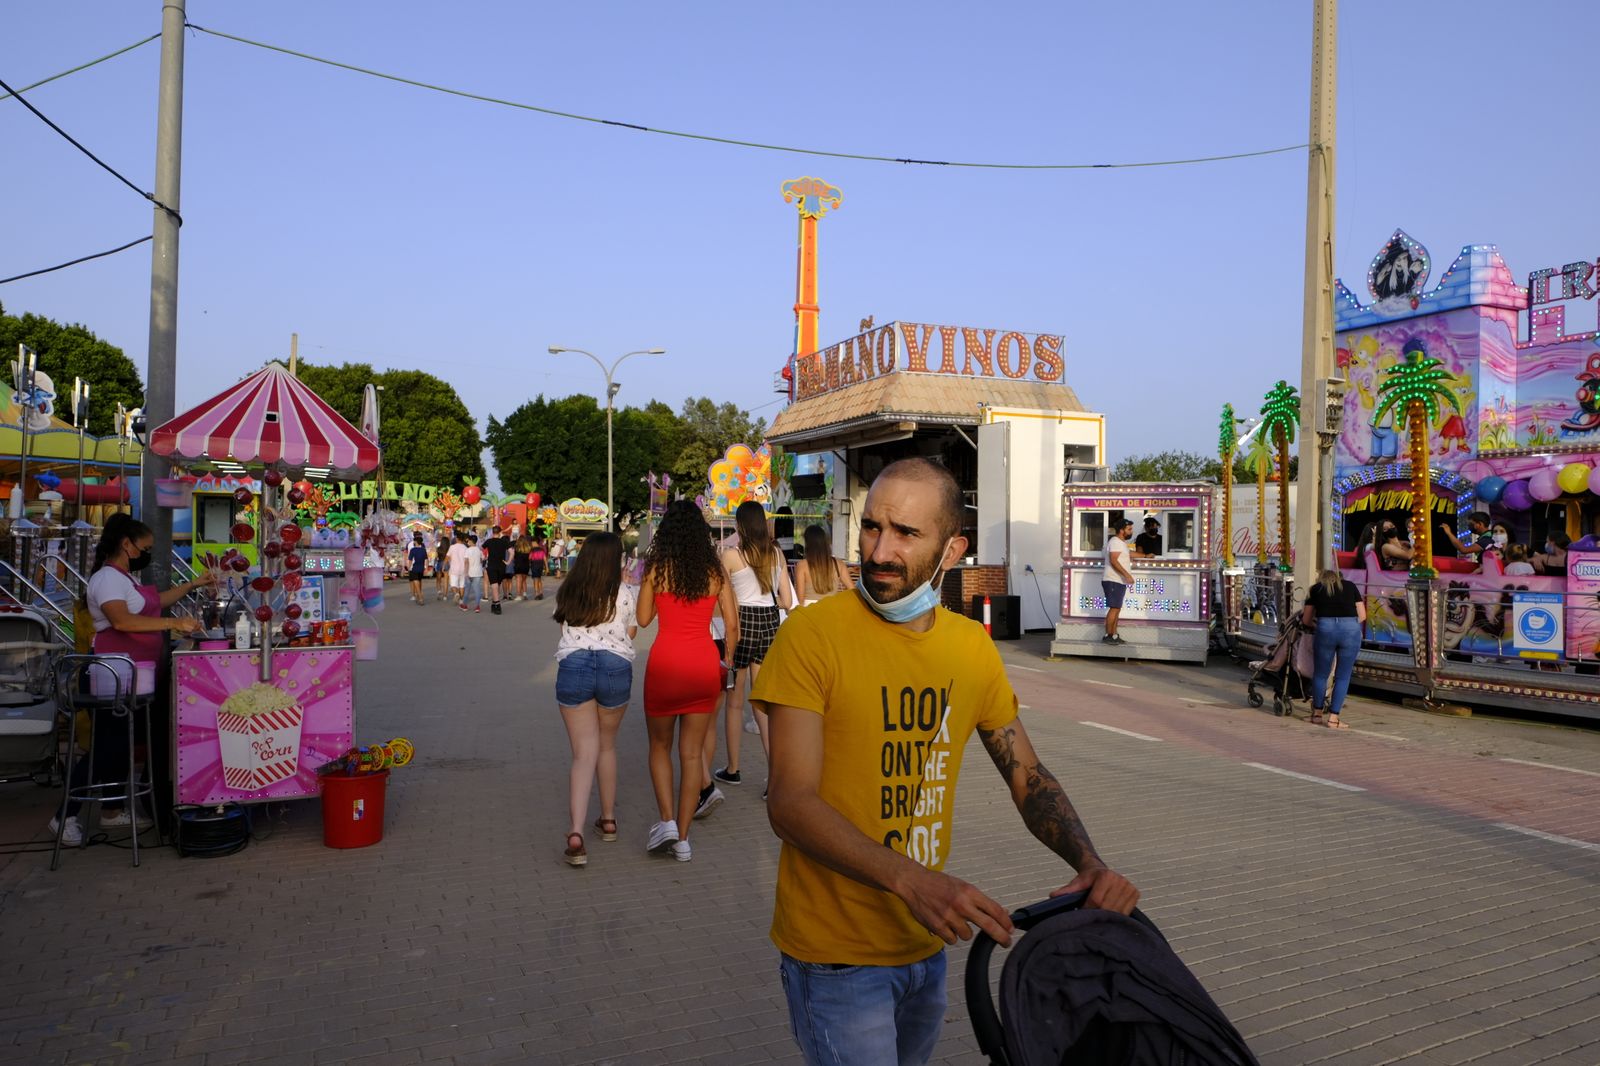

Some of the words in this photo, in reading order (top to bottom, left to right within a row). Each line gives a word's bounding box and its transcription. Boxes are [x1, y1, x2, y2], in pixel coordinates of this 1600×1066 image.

[1529, 257, 1600, 304] TR
[825, 315, 896, 390] MAÑO
[899, 322, 1064, 381] VINOS
[335, 481, 437, 504] USANO
[1094, 499, 1124, 507] VENTA
[1127, 499, 1141, 507] DE
[1144, 499, 1178, 507] FICHAS
[1079, 596, 1191, 613] DISYLANDIA
[881, 685, 952, 744] LOOK
[881, 741, 911, 778] ON
[915, 741, 950, 782] THE
[881, 784, 946, 819] BRIGHT
